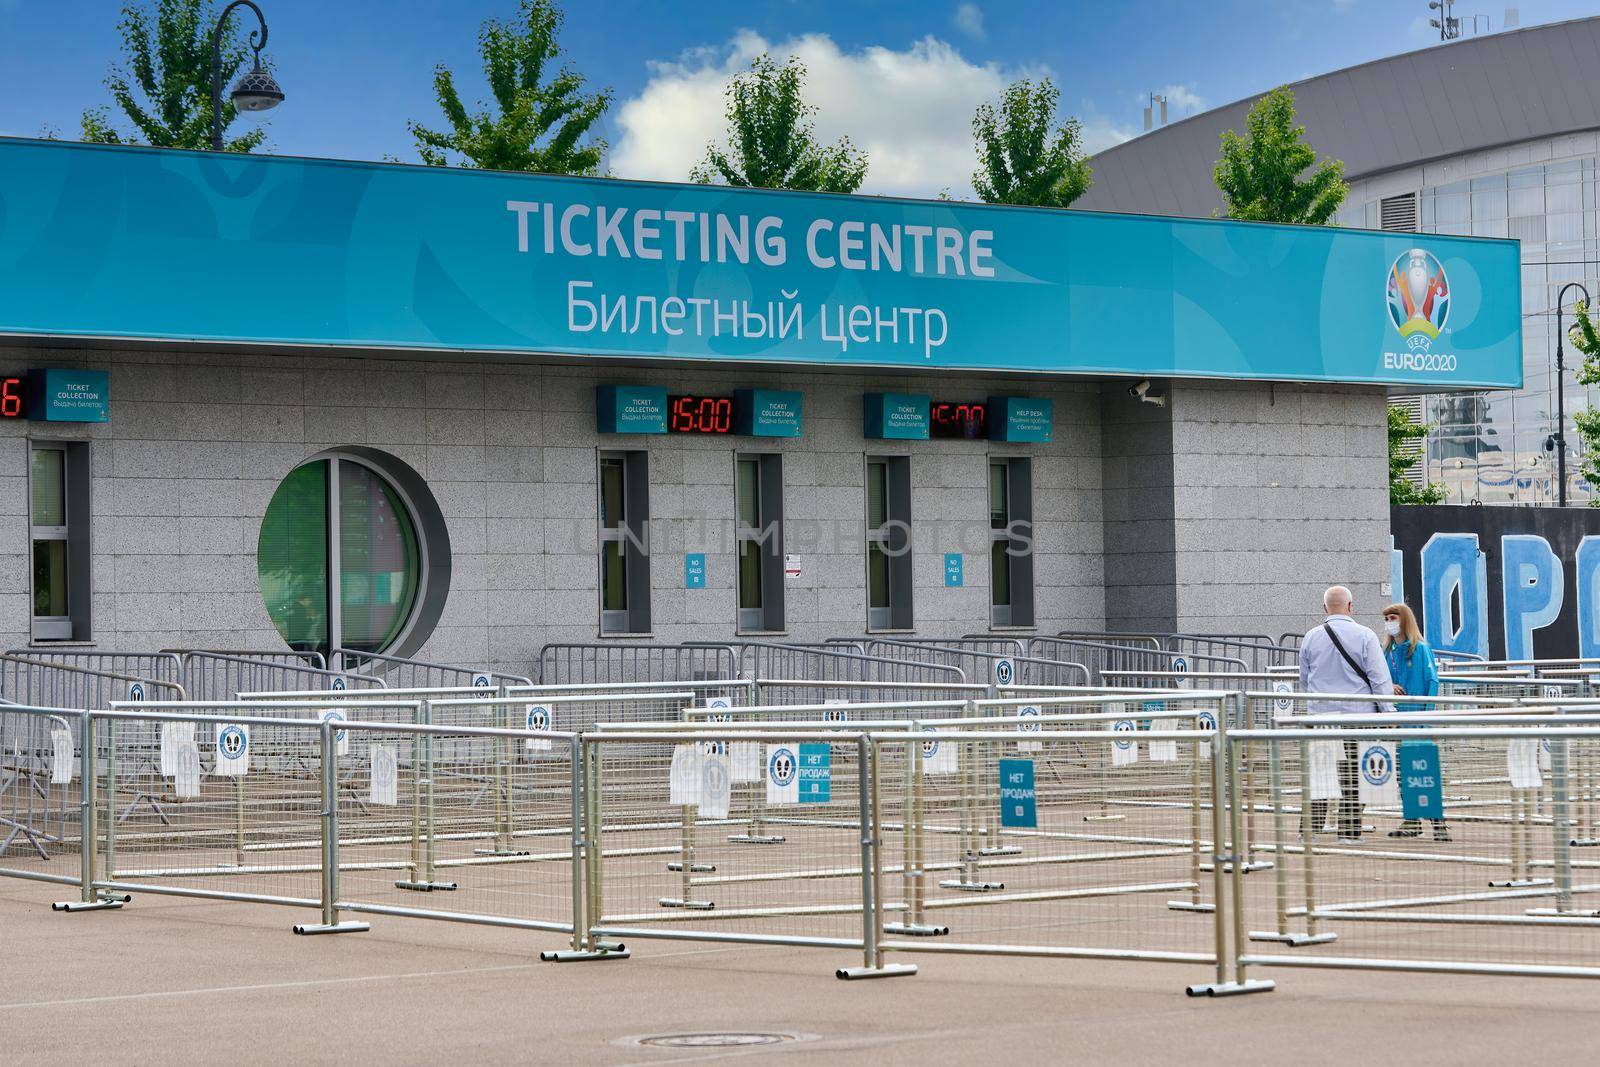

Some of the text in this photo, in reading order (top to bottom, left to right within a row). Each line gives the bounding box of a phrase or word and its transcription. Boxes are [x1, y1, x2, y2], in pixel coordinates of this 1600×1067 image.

[506, 199, 995, 278] TICKETING CENTRE
[567, 279, 948, 359] Билетный центр
[1407, 337, 1430, 350] UEFA
[66, 383, 90, 391] TICKET
[57, 391, 99, 400] COLLECTION
[672, 398, 731, 432] 15:00
[807, 754, 822, 765] НЕТ
[1411, 759, 1428, 770] NO
[799, 768, 830, 779] ПРОДАЖ
[1008, 772, 1024, 783] НЕТ
[1407, 776, 1435, 788] SALES
